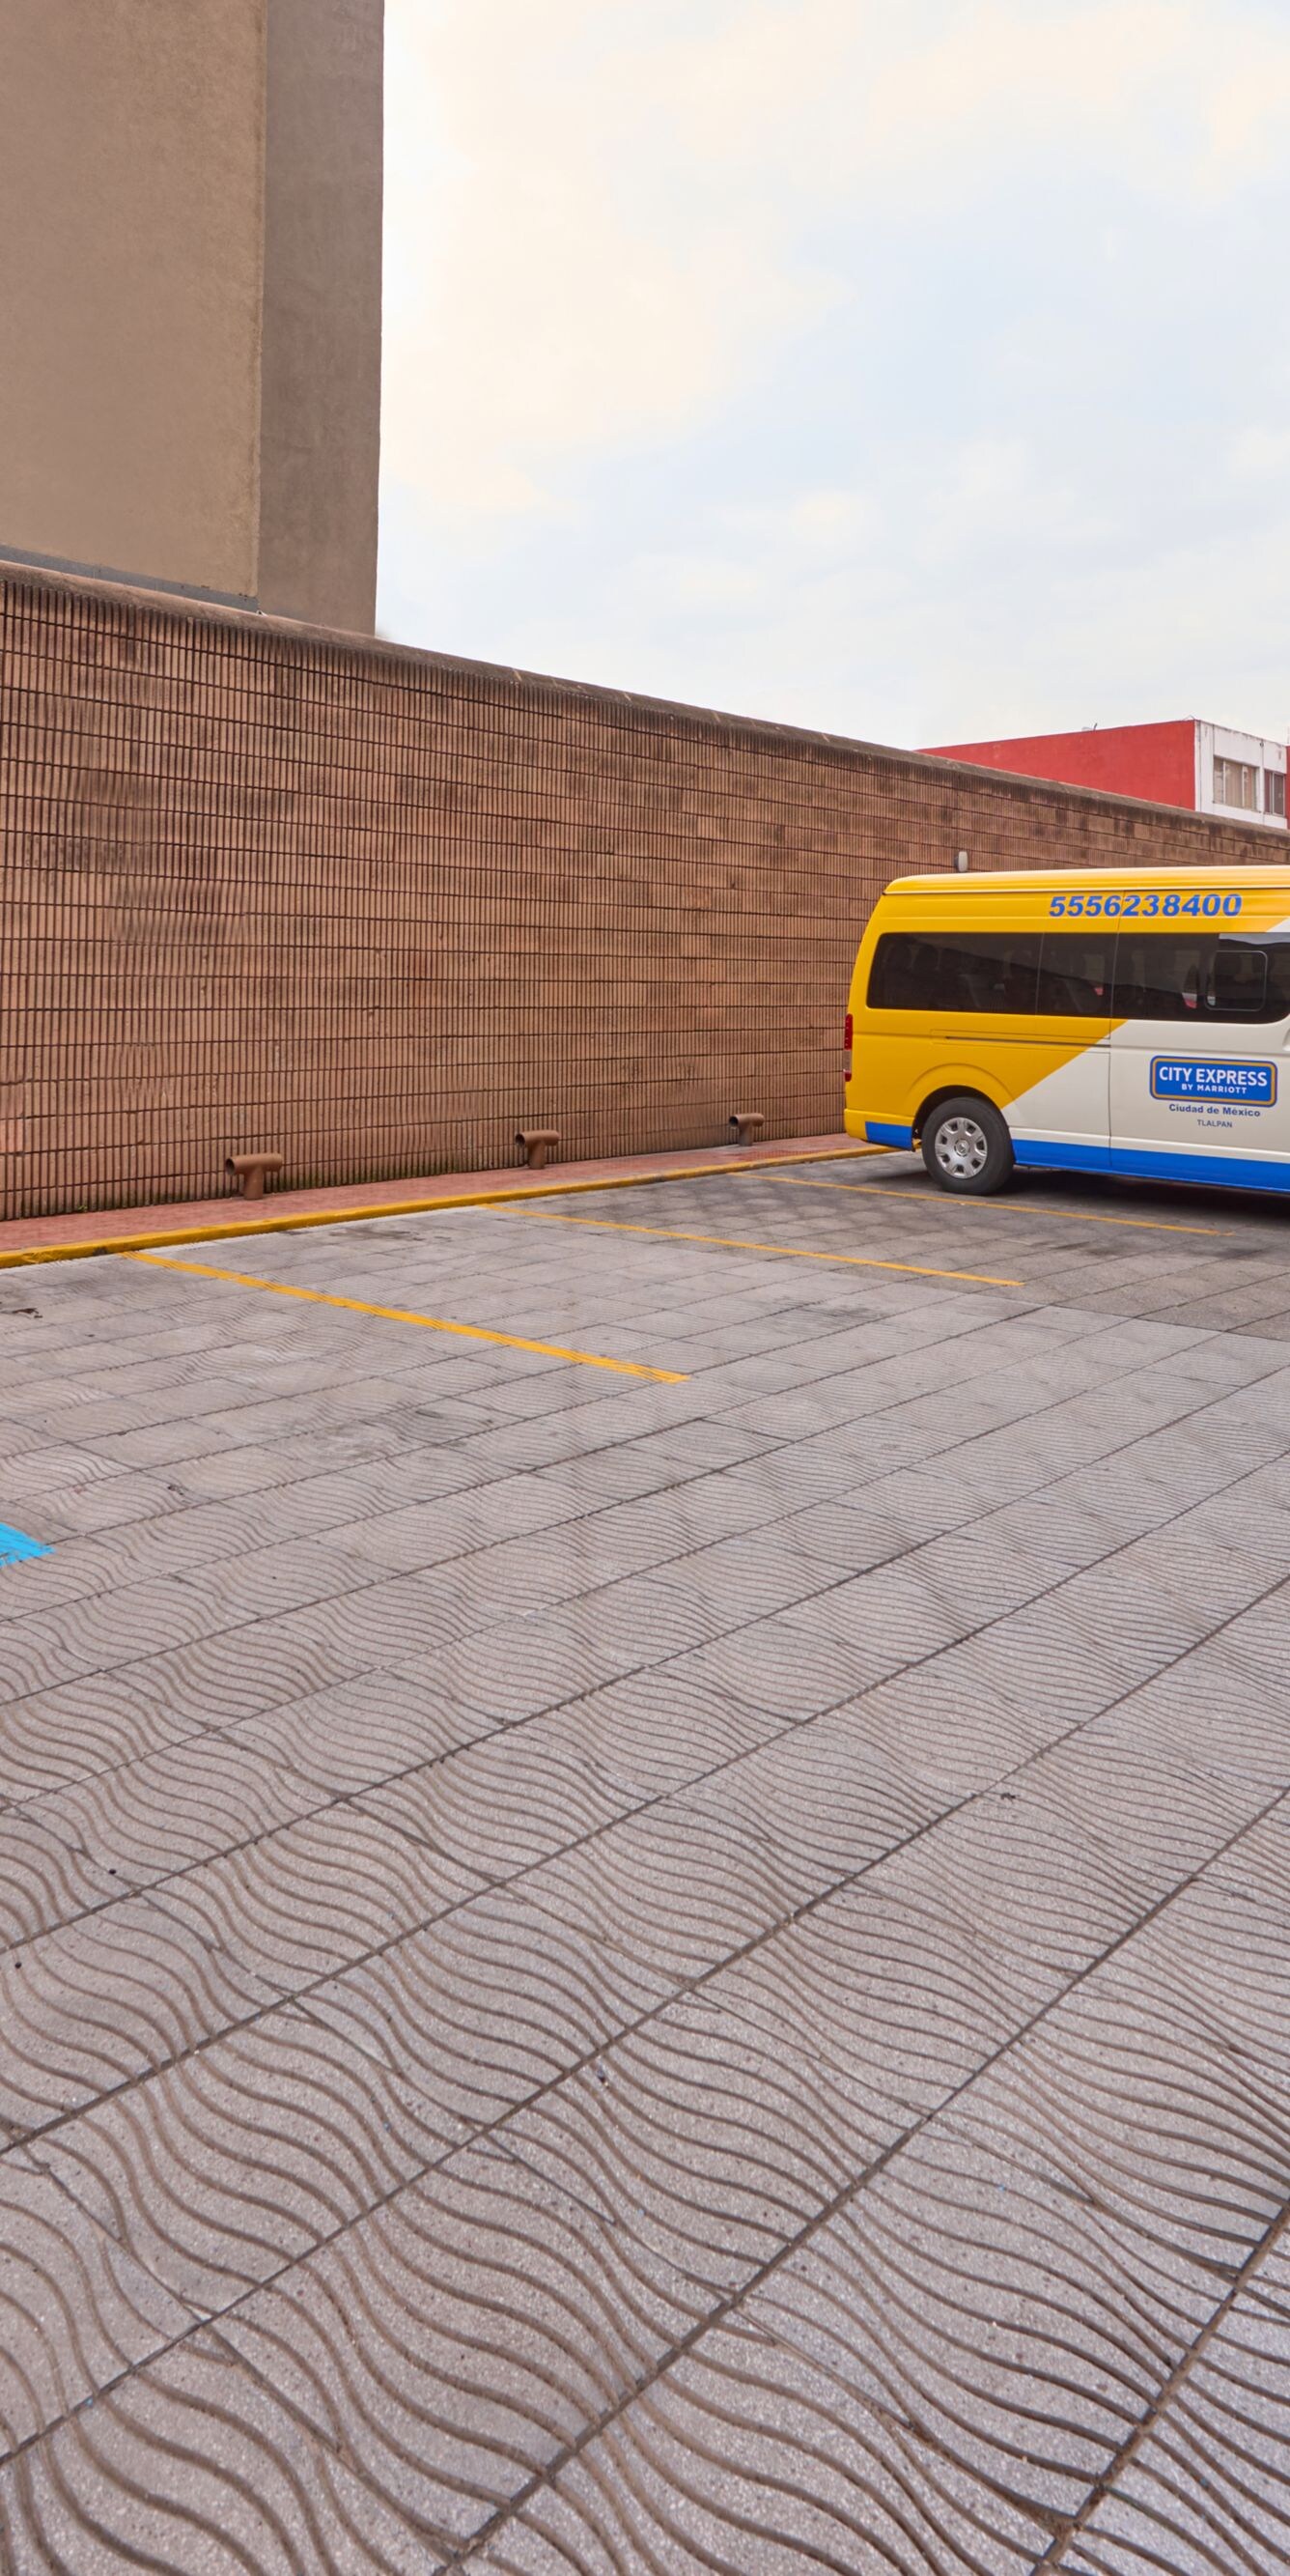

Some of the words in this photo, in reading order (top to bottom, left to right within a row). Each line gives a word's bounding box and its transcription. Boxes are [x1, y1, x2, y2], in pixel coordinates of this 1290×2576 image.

[1049, 893, 1243, 917] 5556238400
[1159, 1066, 1192, 1082] CITY
[1195, 1068, 1268, 1087] EXPRESS
[1197, 1084, 1248, 1094] MARRIOTT
[1168, 1103, 1204, 1114] Ciudad
[1206, 1106, 1220, 1115] de
[1222, 1107, 1261, 1118] México
[1196, 1119, 1233, 1128] TLALPAN
